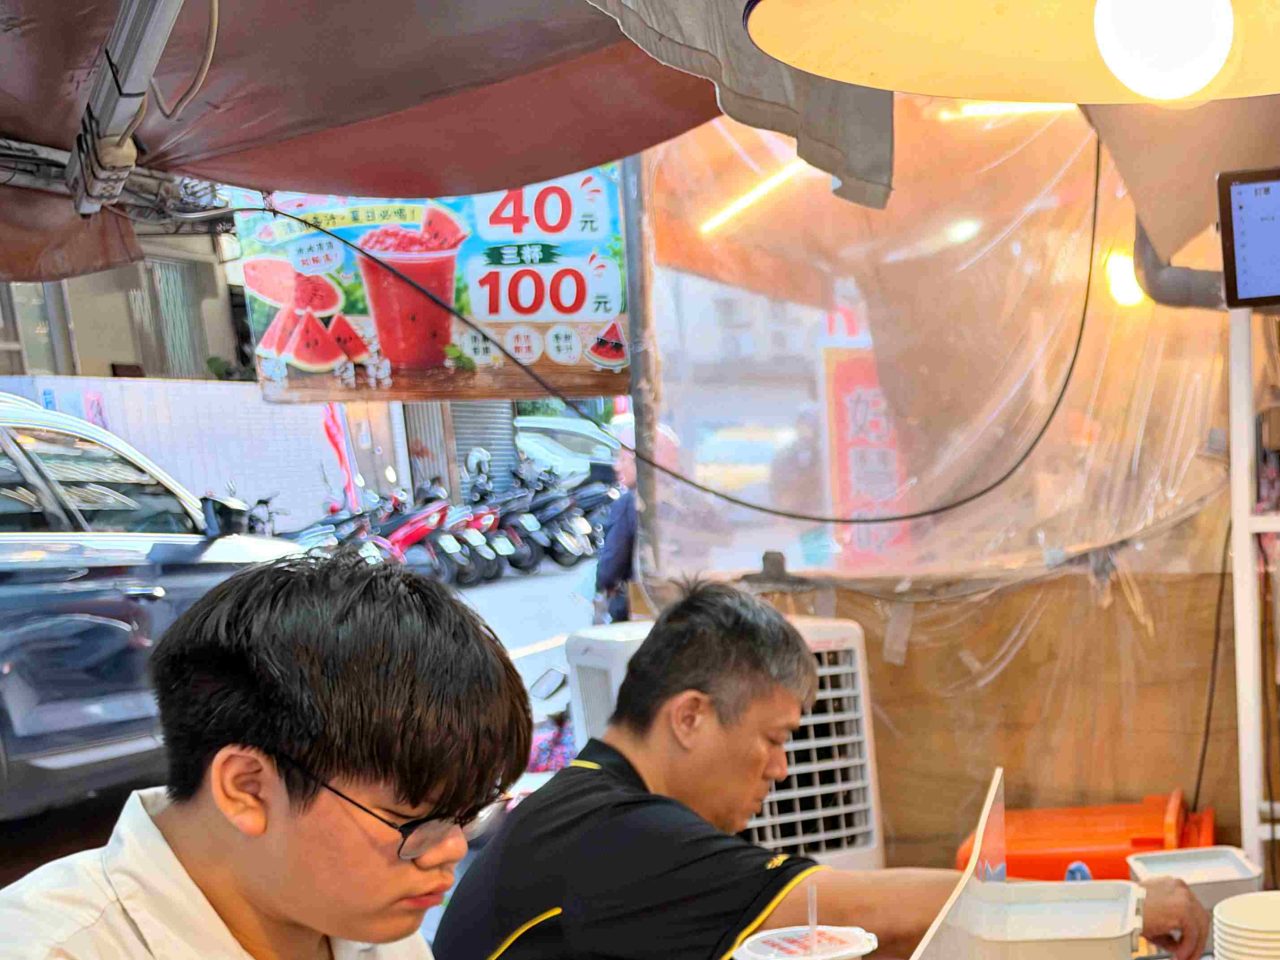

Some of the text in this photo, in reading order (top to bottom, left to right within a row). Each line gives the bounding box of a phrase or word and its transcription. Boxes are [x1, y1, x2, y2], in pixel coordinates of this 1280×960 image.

[489, 186, 598, 235] 40 元
[478, 268, 612, 316] 100 元
